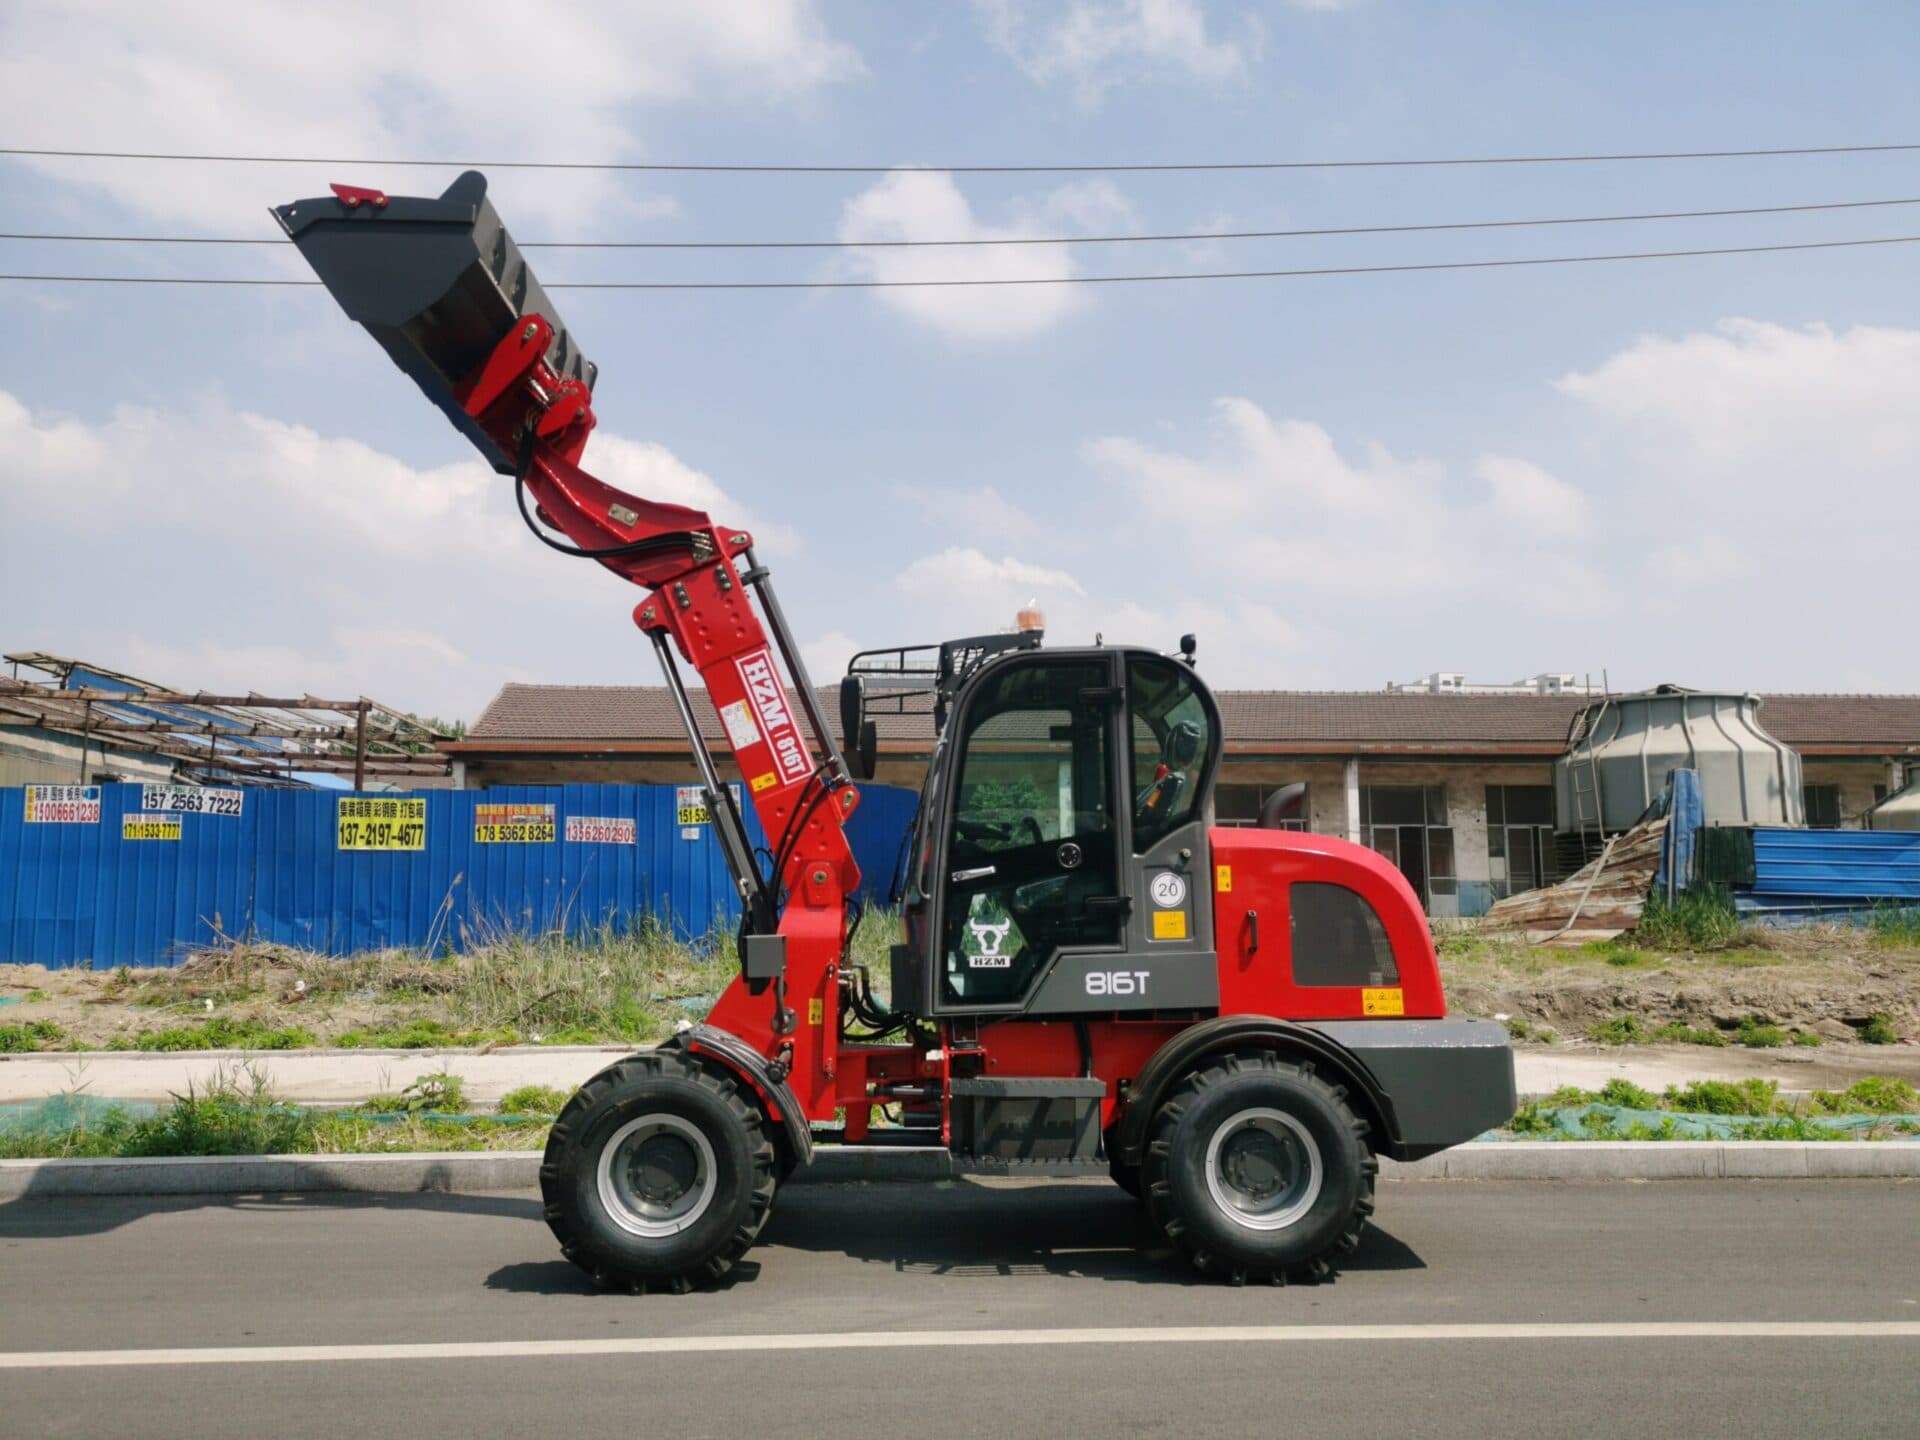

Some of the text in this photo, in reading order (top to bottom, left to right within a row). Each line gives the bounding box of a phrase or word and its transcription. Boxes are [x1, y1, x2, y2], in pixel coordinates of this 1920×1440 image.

[743, 659, 806, 774] HZM 816T
[34, 802, 99, 821] 15006661238
[340, 823, 424, 846] 137-2197-4677
[476, 825, 553, 841] 178 5362 8264
[1158, 883, 1178, 897] 20
[973, 957, 1007, 966] HZM
[1084, 971, 1151, 995] 816T
